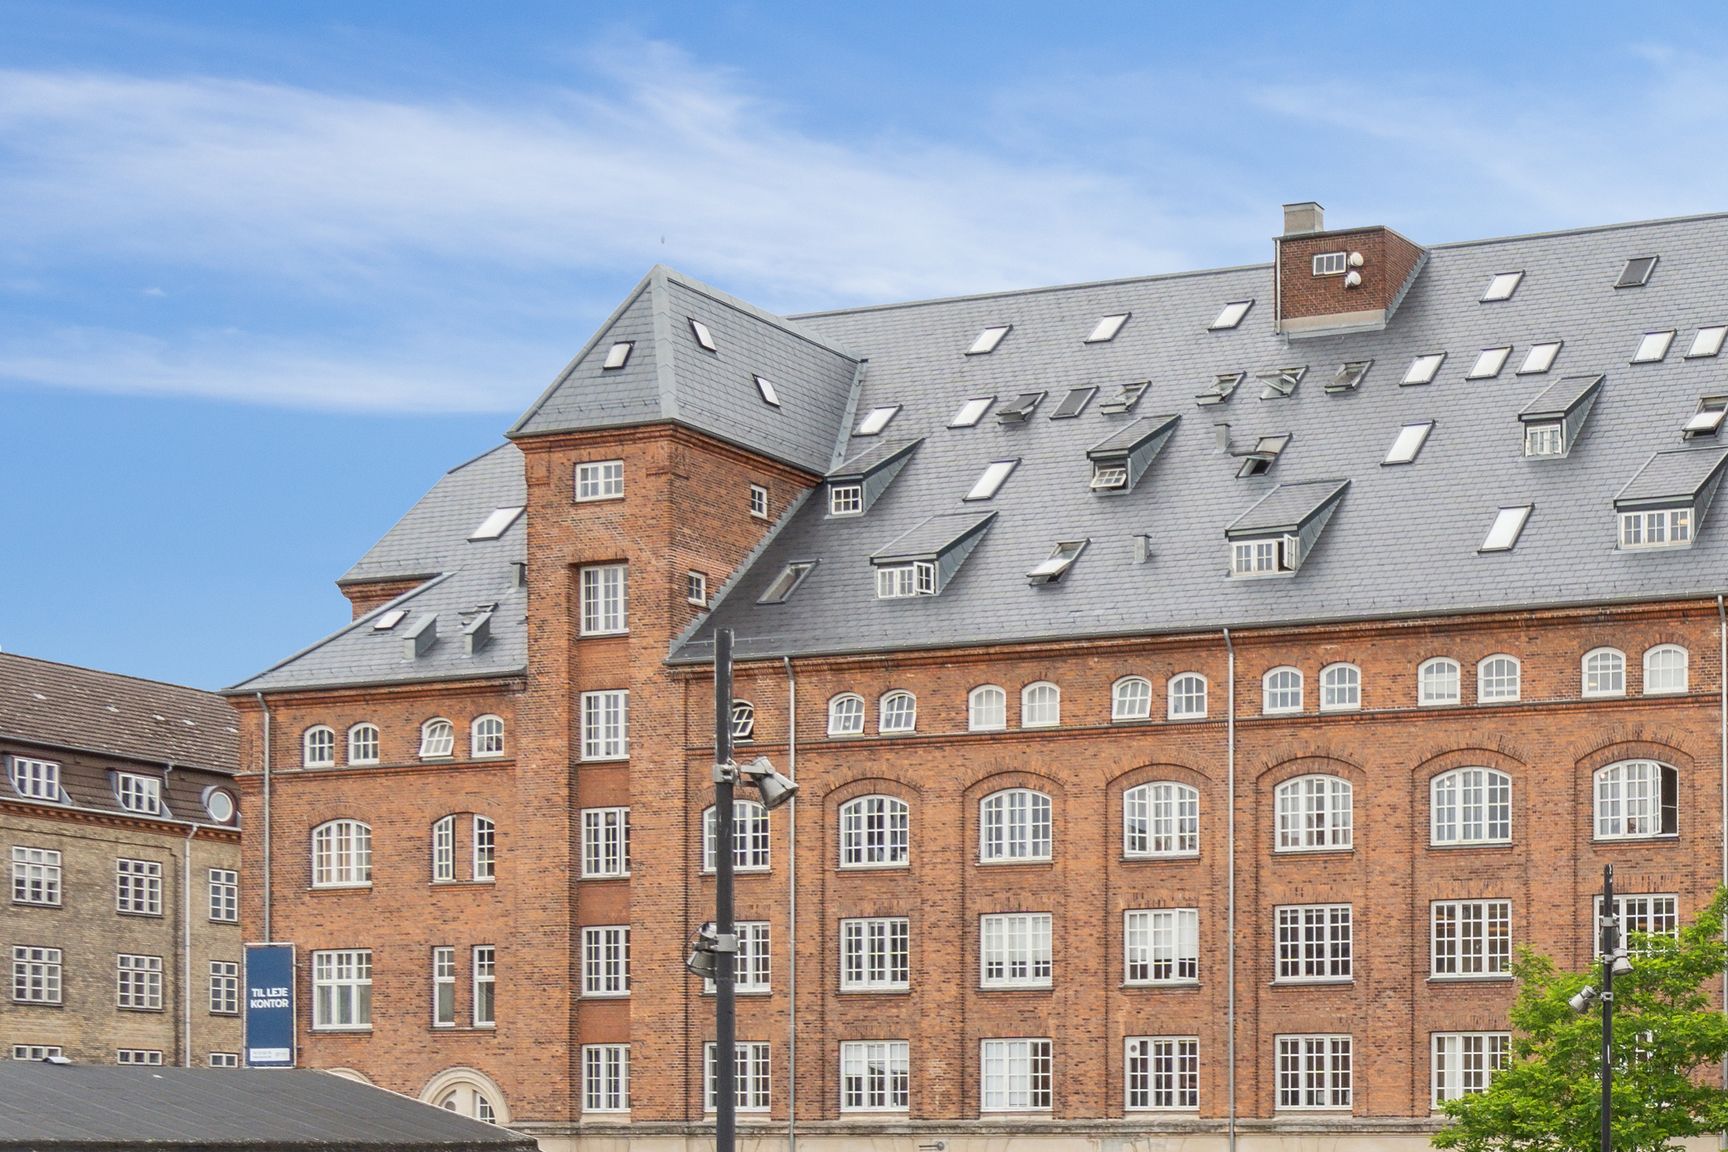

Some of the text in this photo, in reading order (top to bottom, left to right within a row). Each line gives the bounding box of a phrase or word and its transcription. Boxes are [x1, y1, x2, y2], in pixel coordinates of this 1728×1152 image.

[251, 987, 288, 997] TIL LEJE
[250, 999, 289, 1008] KONTOR
